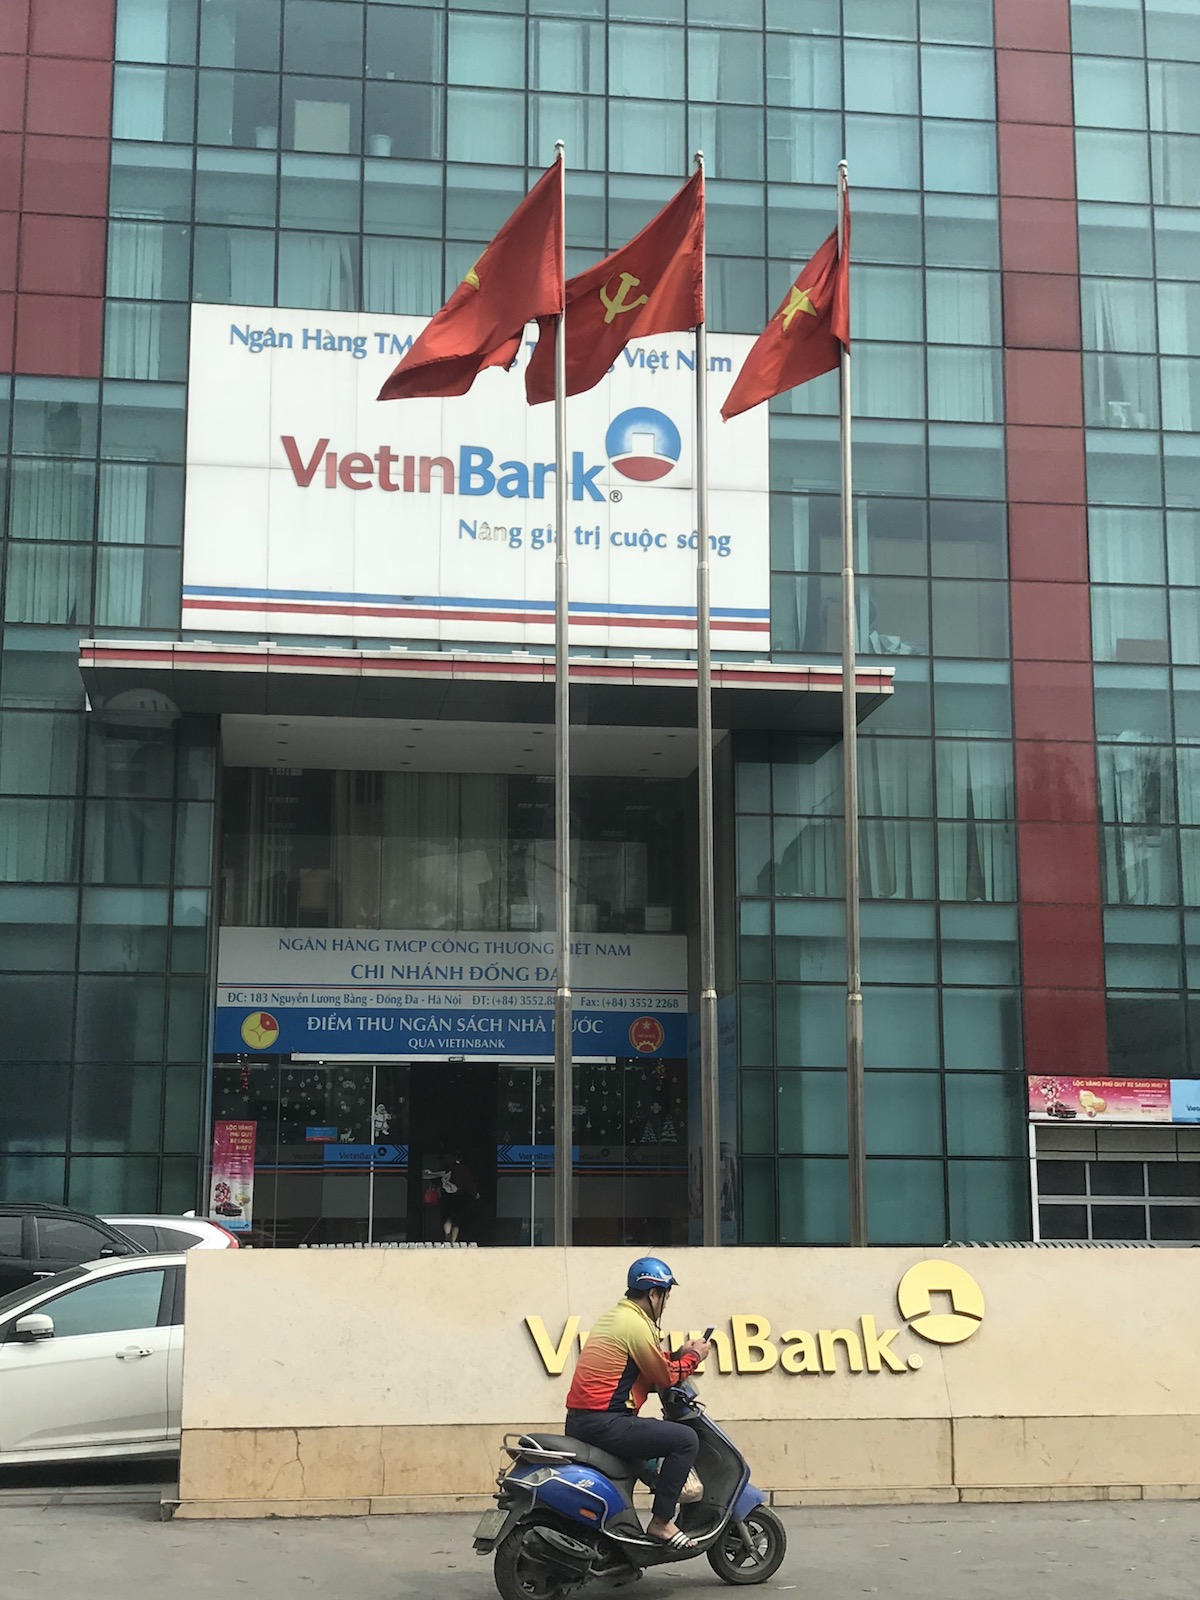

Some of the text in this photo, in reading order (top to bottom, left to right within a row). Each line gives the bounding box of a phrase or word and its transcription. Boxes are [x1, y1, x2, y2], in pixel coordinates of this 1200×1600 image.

[230, 324, 293, 354] Ngân
[302, 328, 367, 360] Hàng
[622, 346, 669, 374] Việt
[677, 349, 732, 373] Nm
[280, 435, 607, 502] VietinBank
[458, 519, 522, 549] Nâng
[531, 523, 556, 550] gi
[574, 525, 600, 550] trị
[610, 528, 667, 552] cuộc
[279, 937, 632, 958] NGÂN HÀNG TMCP CÔNG THƯƠNG IỆT NAM
[351, 964, 384, 979] CHI
[391, 962, 463, 980] NHÁNH
[469, 962, 529, 982] ĐỐNG
[227, 992, 247, 1003] ĐC:
[249, 992, 268, 1003] 183
[311, 993, 341, 1006] Lương
[404, 994, 419, 1004] Đa
[428, 994, 442, 1005] Hà
[444, 994, 461, 1006] Nội
[472, 995, 490, 1005] ĐT:
[492, 995, 518, 1006] (+84)
[580, 997, 600, 1007] Fax:
[602, 997, 627, 1008] (+84)
[630, 998, 653, 1008] 3552
[655, 998, 679, 1009] 2268
[307, 1012, 352, 1031] ĐIỂM
[356, 1017, 395, 1031] THU
[399, 1015, 452, 1032] NGÂN
[457, 1014, 503, 1032] SÁCH
[508, 1015, 547, 1033] NHÀ
[408, 1038, 506, 1050] QUA VIETINBANK
